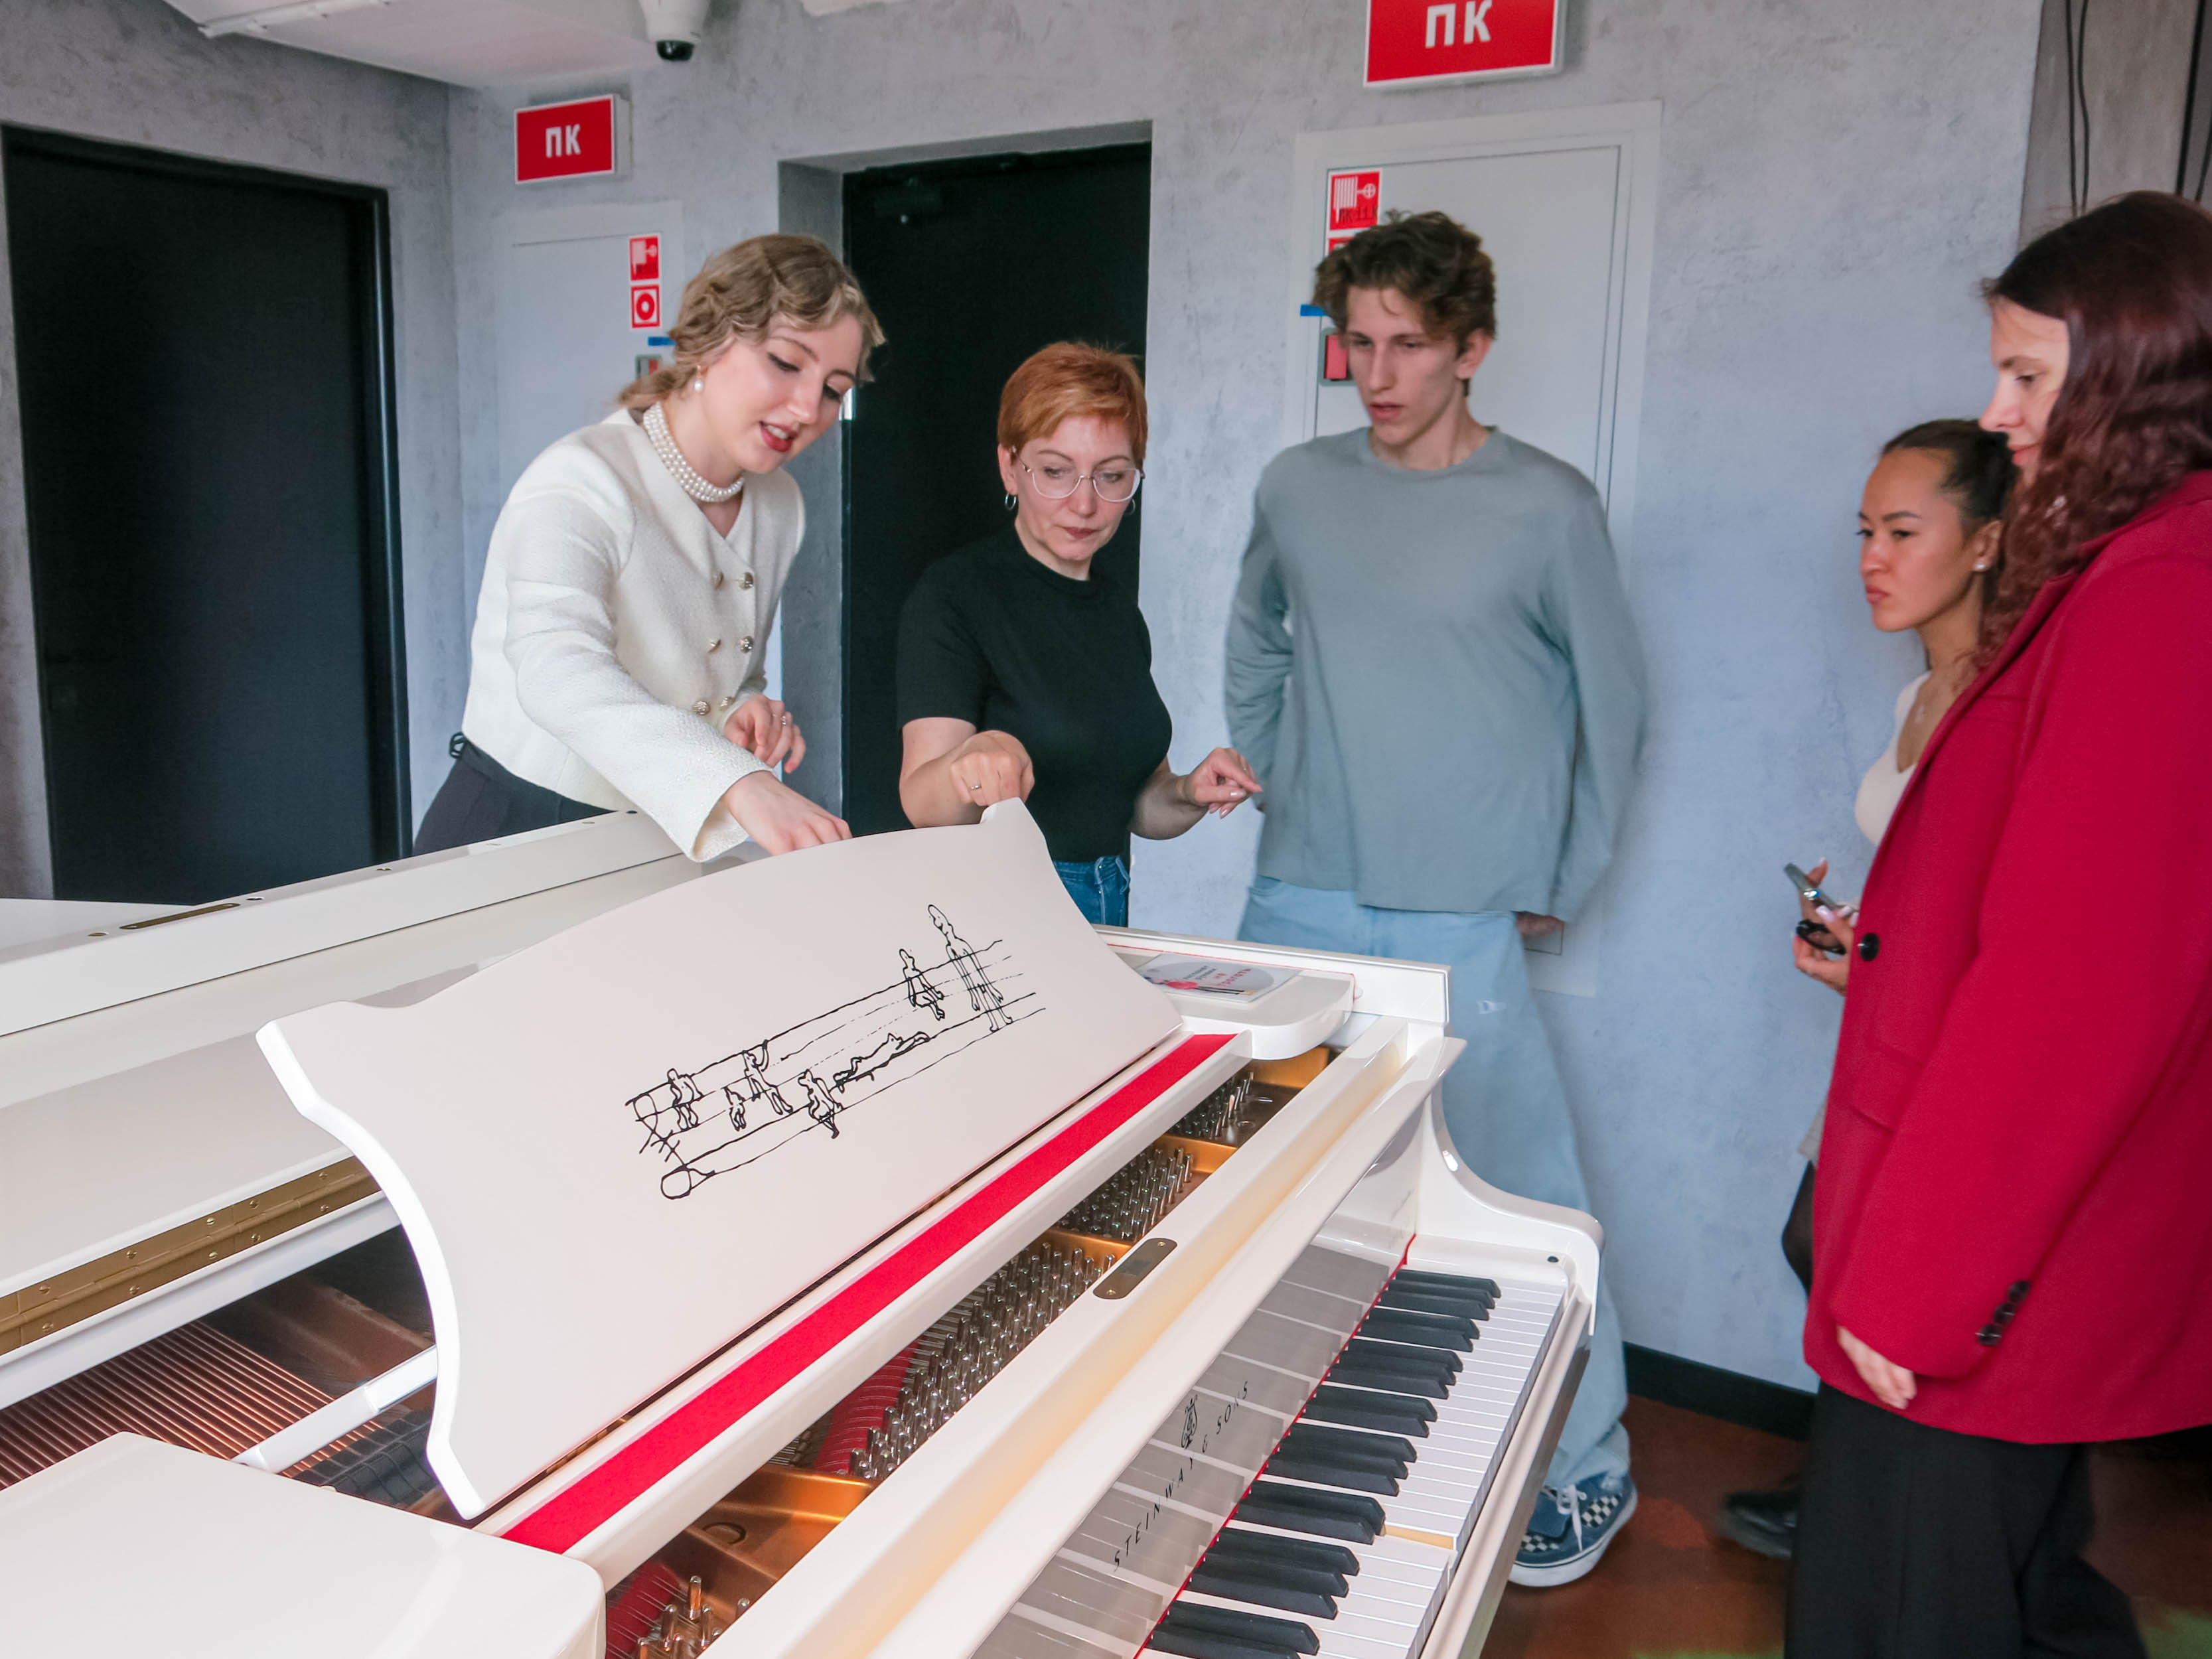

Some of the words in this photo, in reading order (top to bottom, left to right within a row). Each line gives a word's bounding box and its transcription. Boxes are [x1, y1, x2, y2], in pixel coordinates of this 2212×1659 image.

[1425, 0, 1492, 48] ПК
[545, 123, 581, 159] ПК
[1114, 1453, 1194, 1572] STEINWAY
[1216, 1380, 1248, 1435] SONS
